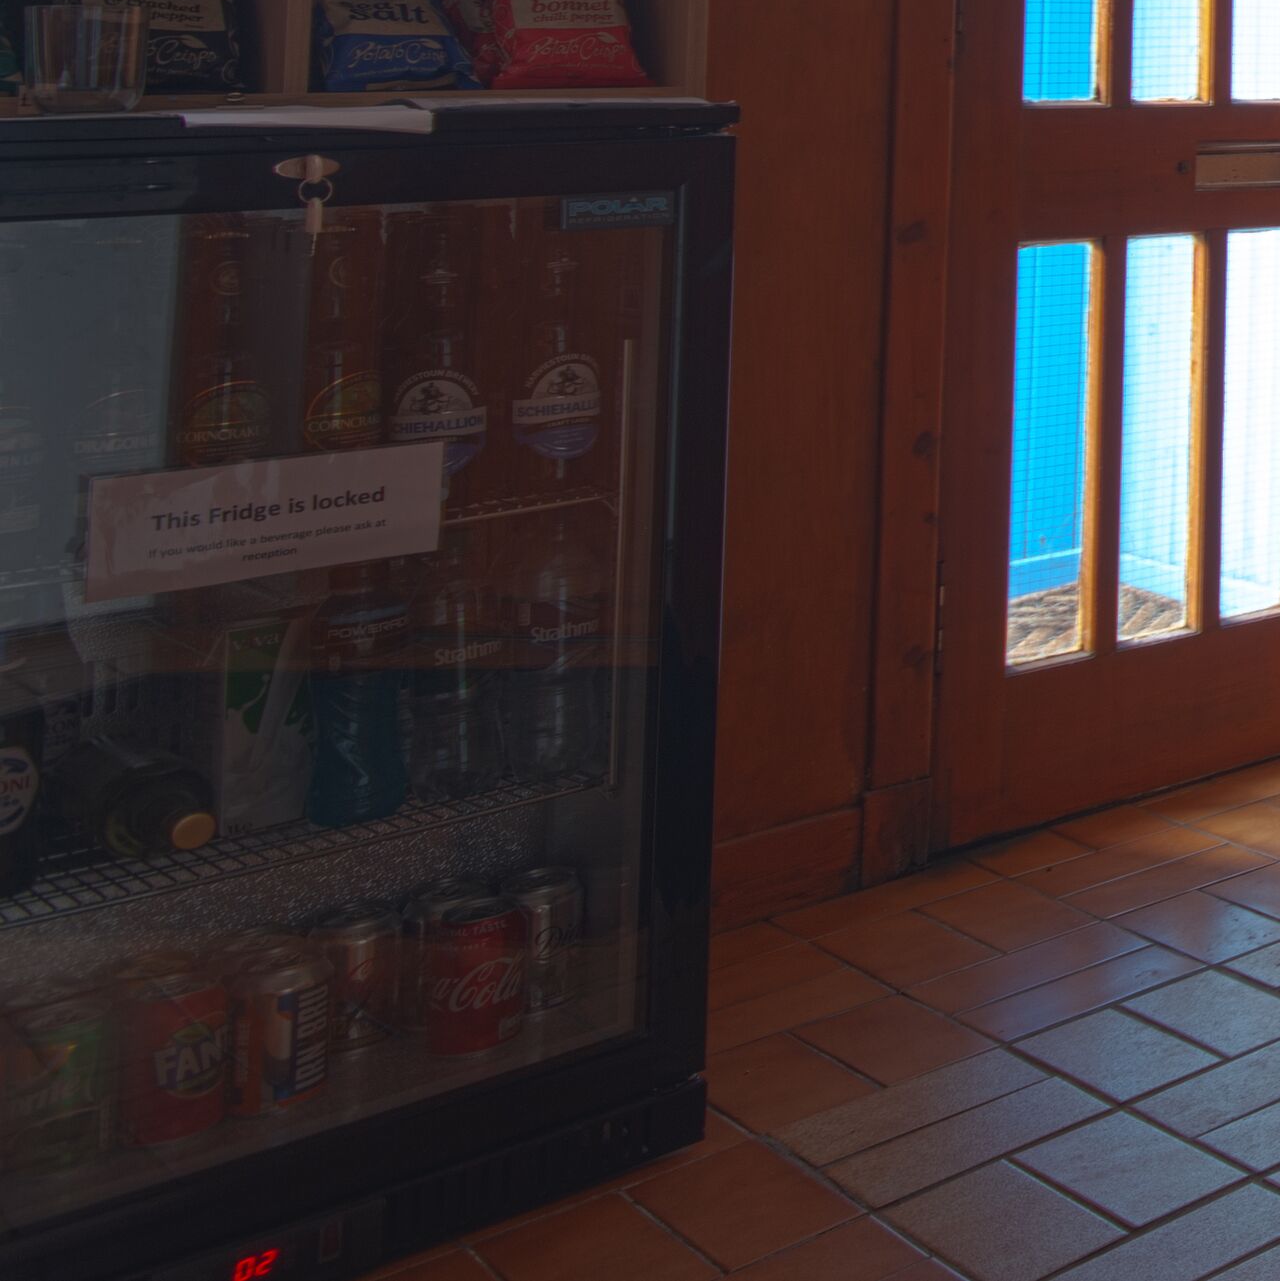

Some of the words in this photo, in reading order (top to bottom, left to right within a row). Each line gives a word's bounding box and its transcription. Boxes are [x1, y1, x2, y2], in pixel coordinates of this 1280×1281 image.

[127, 0, 201, 13] cracked
[152, 10, 203, 23] pepper
[349, 2, 429, 25] salt
[533, 12, 567, 23] chilli
[570, 12, 613, 23] pepper
[568, 197, 669, 217] POLAR
[152, 511, 201, 532] This
[209, 501, 281, 525] Fridge
[288, 497, 306, 514] is
[312, 486, 386, 512] locked
[148, 548, 158, 560] If
[160, 548, 183, 560] you
[186, 540, 224, 554] would
[225, 537, 246, 549] like
[249, 538, 257, 547] a
[260, 528, 313, 546] beverage
[316, 523, 352, 539] please
[354, 519, 372, 531] ask
[374, 518, 387, 528] at
[242, 546, 298, 562] reception
[153, 1023, 230, 1089] FAN
[233, 1247, 280, 1281] 02
